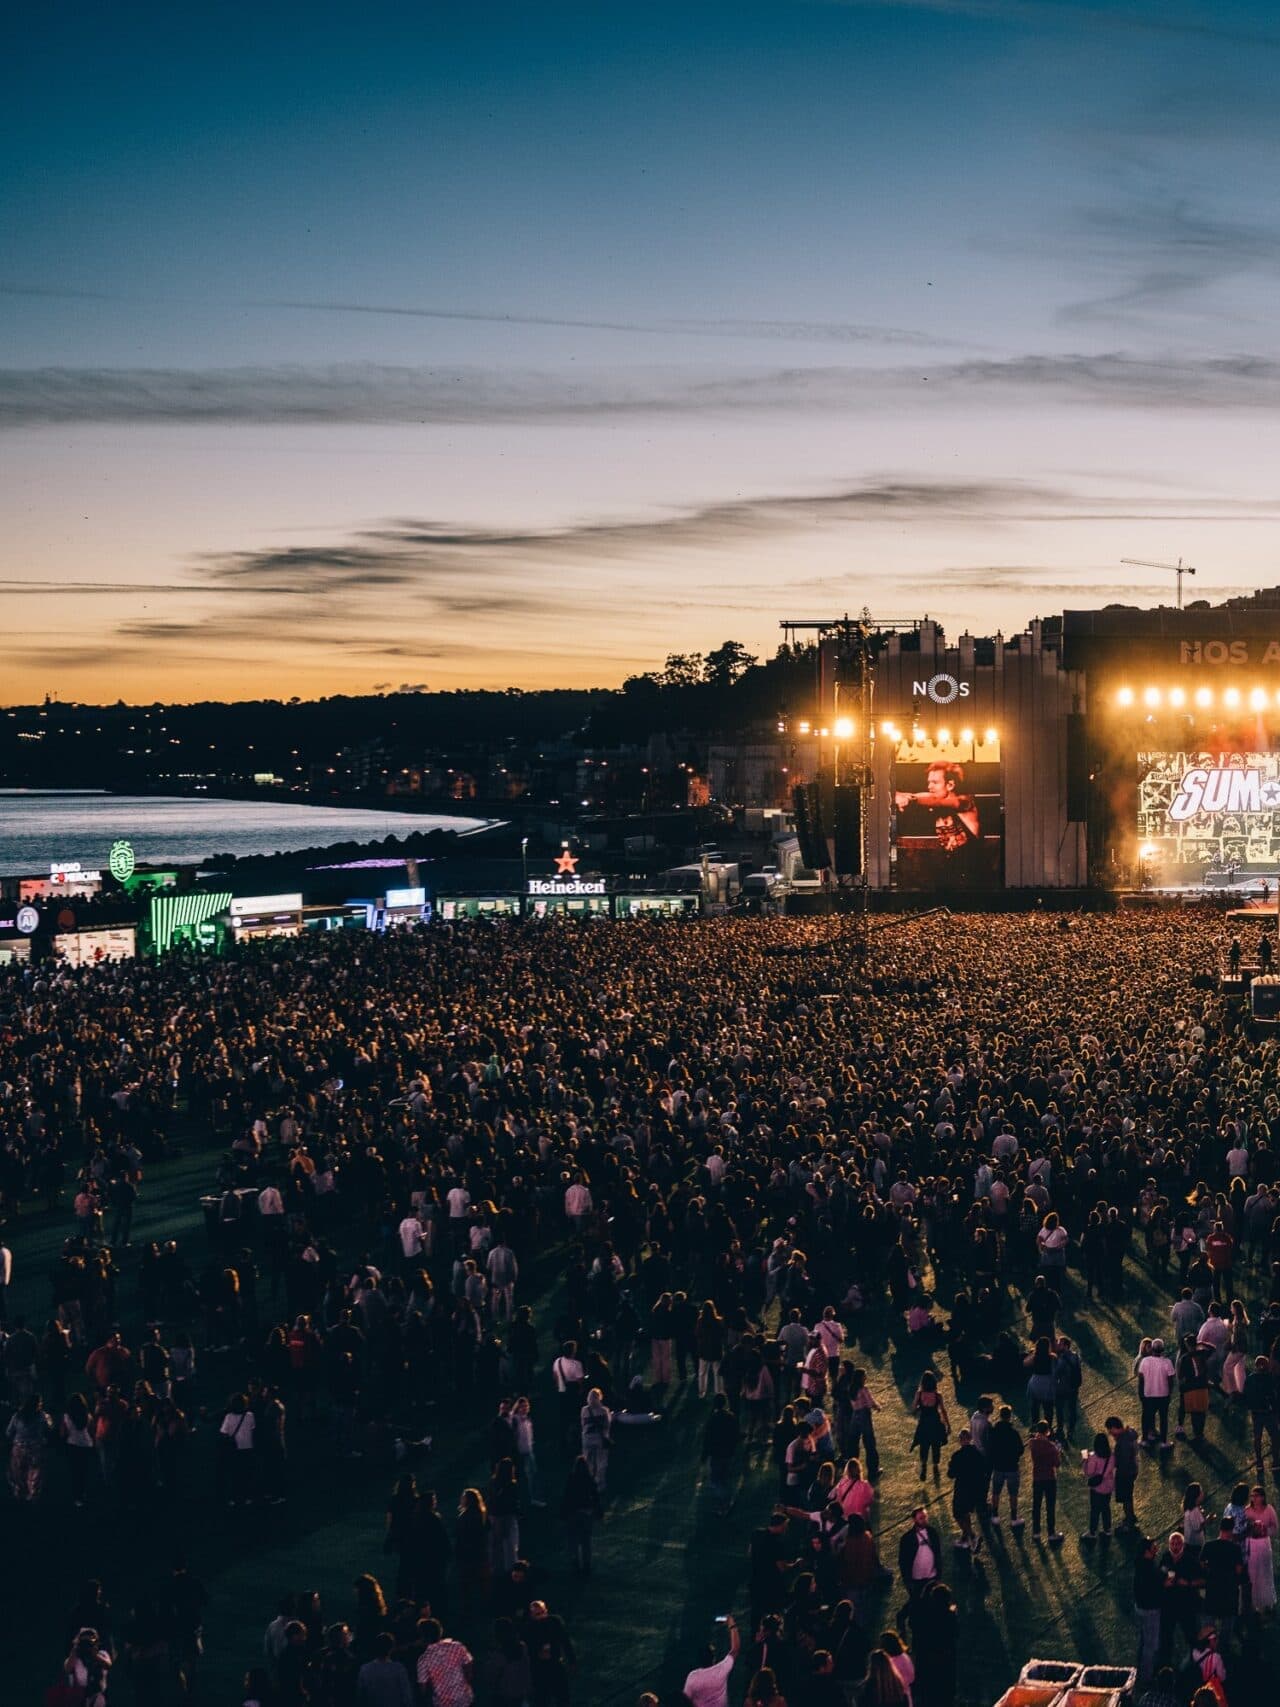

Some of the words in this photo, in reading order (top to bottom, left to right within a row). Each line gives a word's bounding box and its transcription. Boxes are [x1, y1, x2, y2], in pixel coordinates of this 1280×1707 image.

[1180, 641, 1249, 665] NOS
[913, 673, 970, 704] NOS
[528, 879, 606, 894] Heineken
